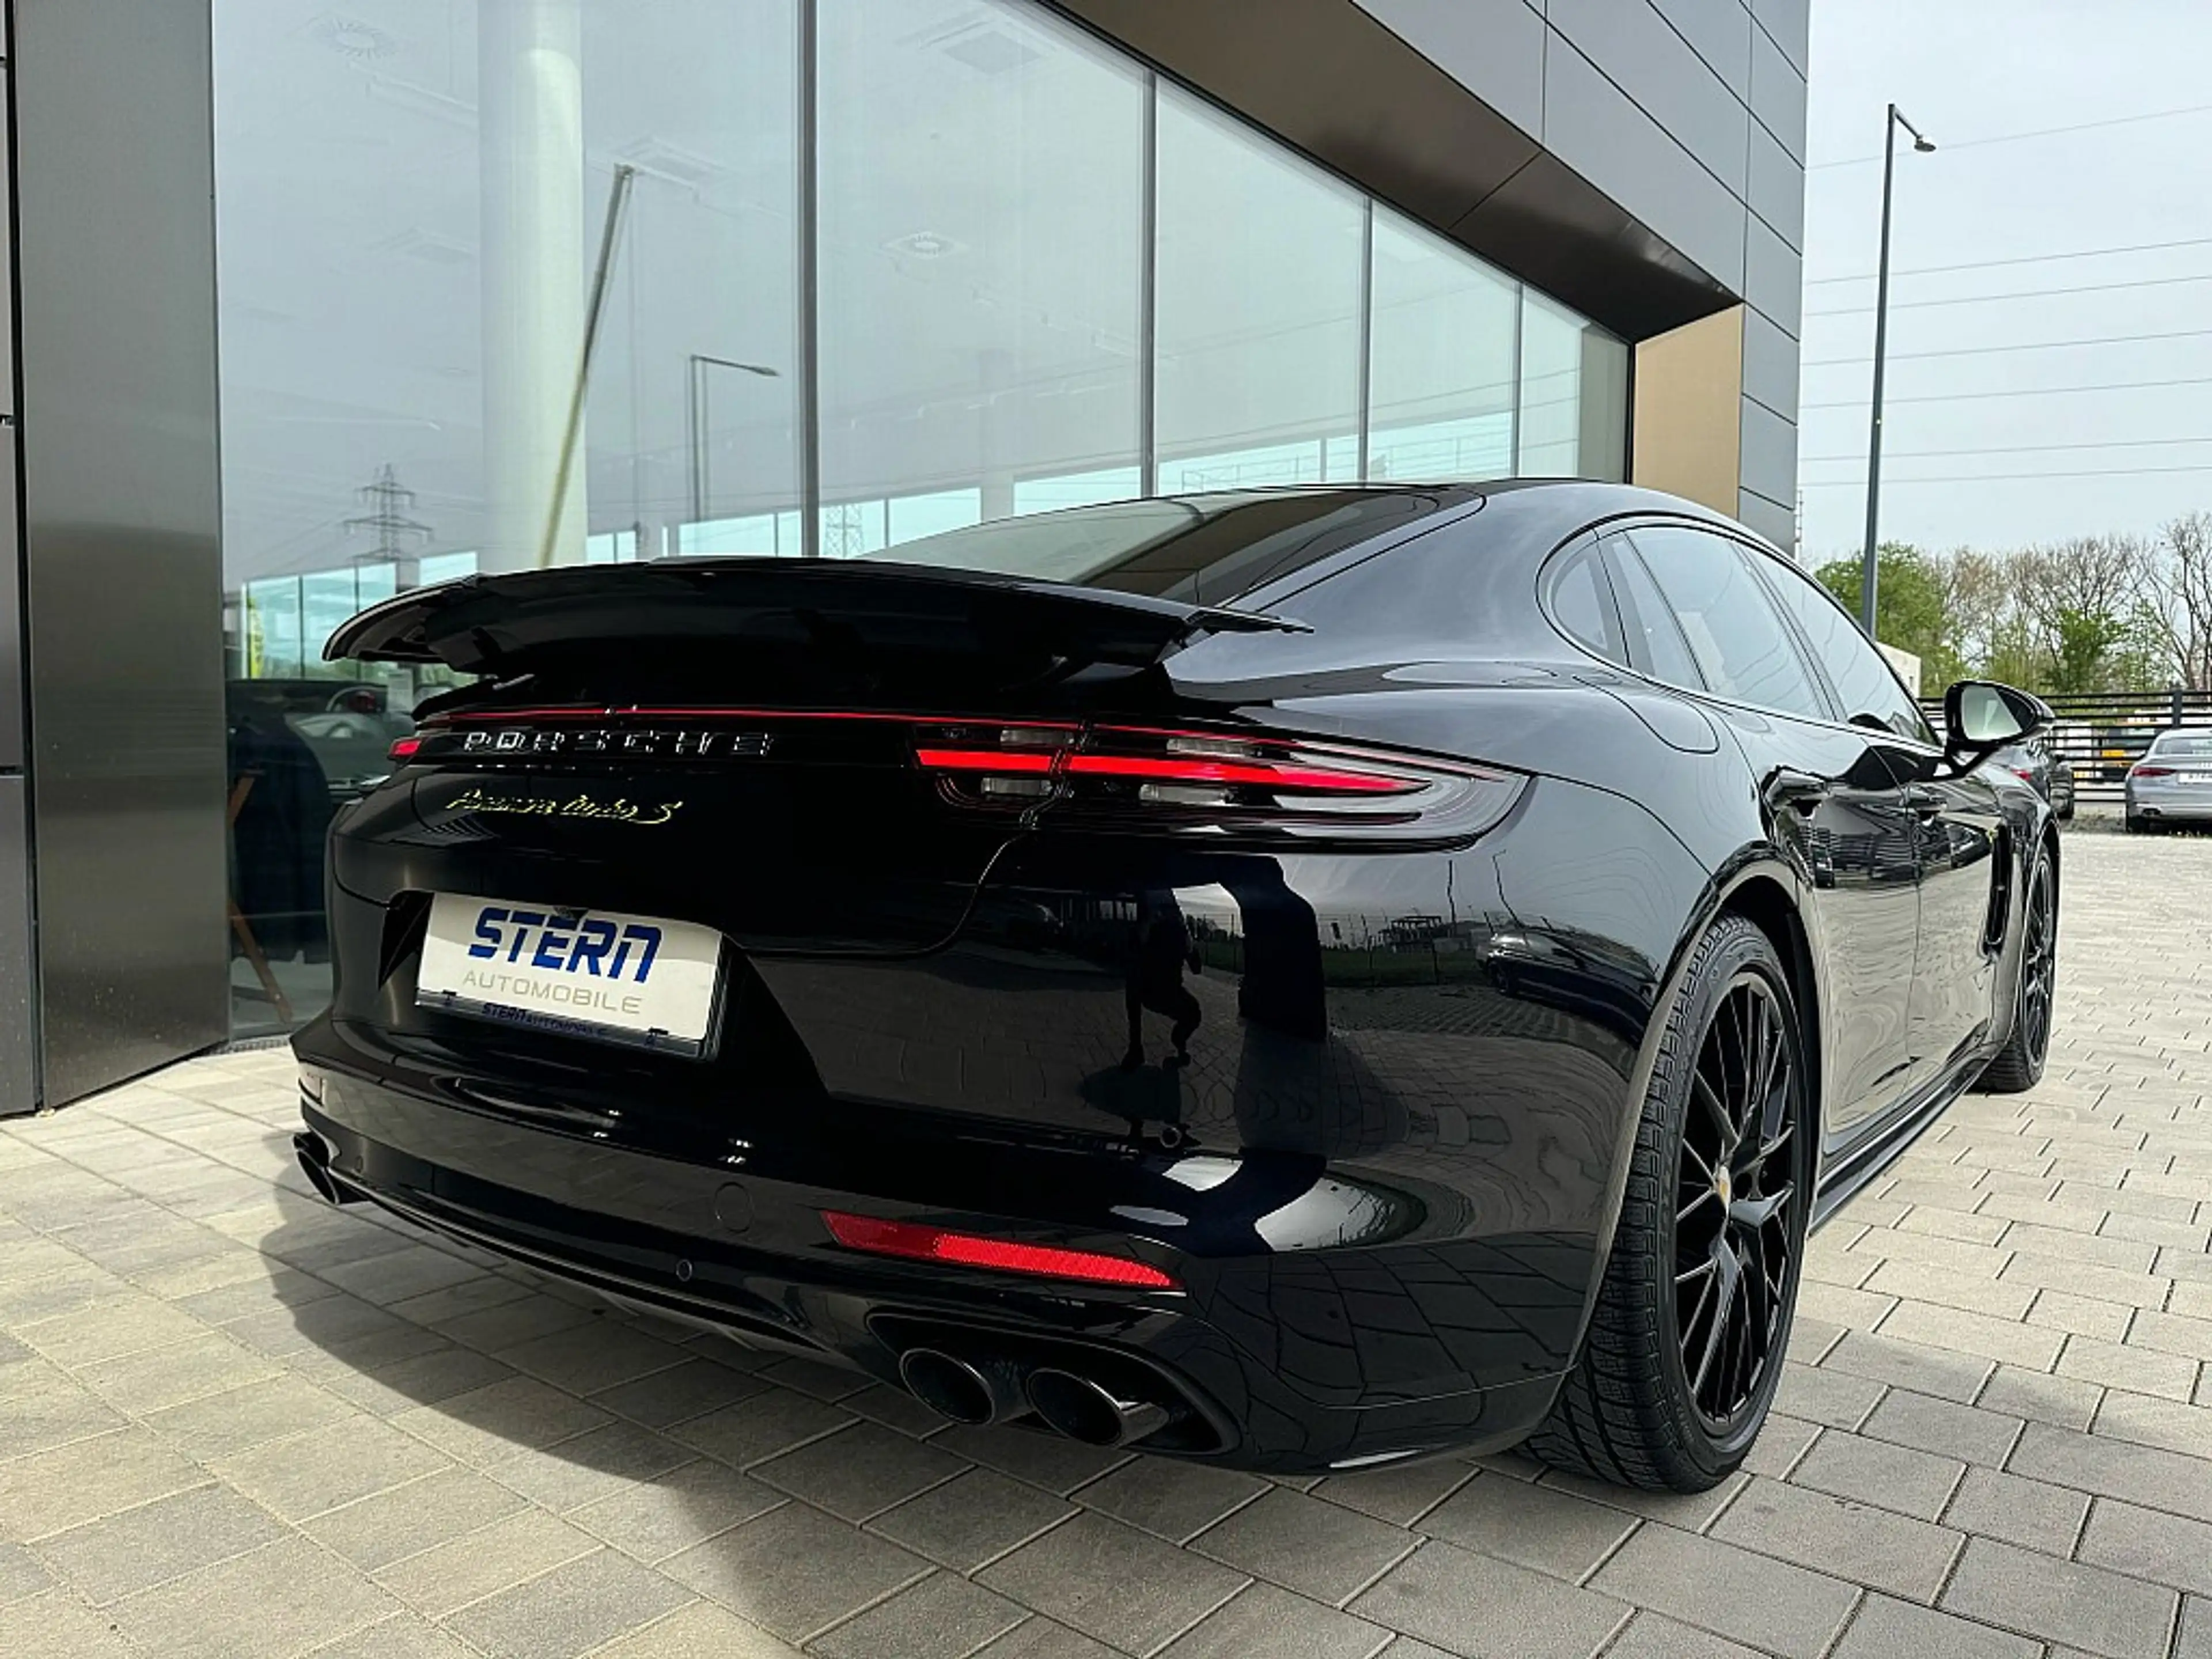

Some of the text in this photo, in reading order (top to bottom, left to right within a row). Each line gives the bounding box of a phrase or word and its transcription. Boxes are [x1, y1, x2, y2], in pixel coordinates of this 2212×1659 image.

[464, 729, 774, 756] PORSCHE
[468, 907, 662, 983] STERN
[463, 969, 643, 1014] AUTOMOBILE
